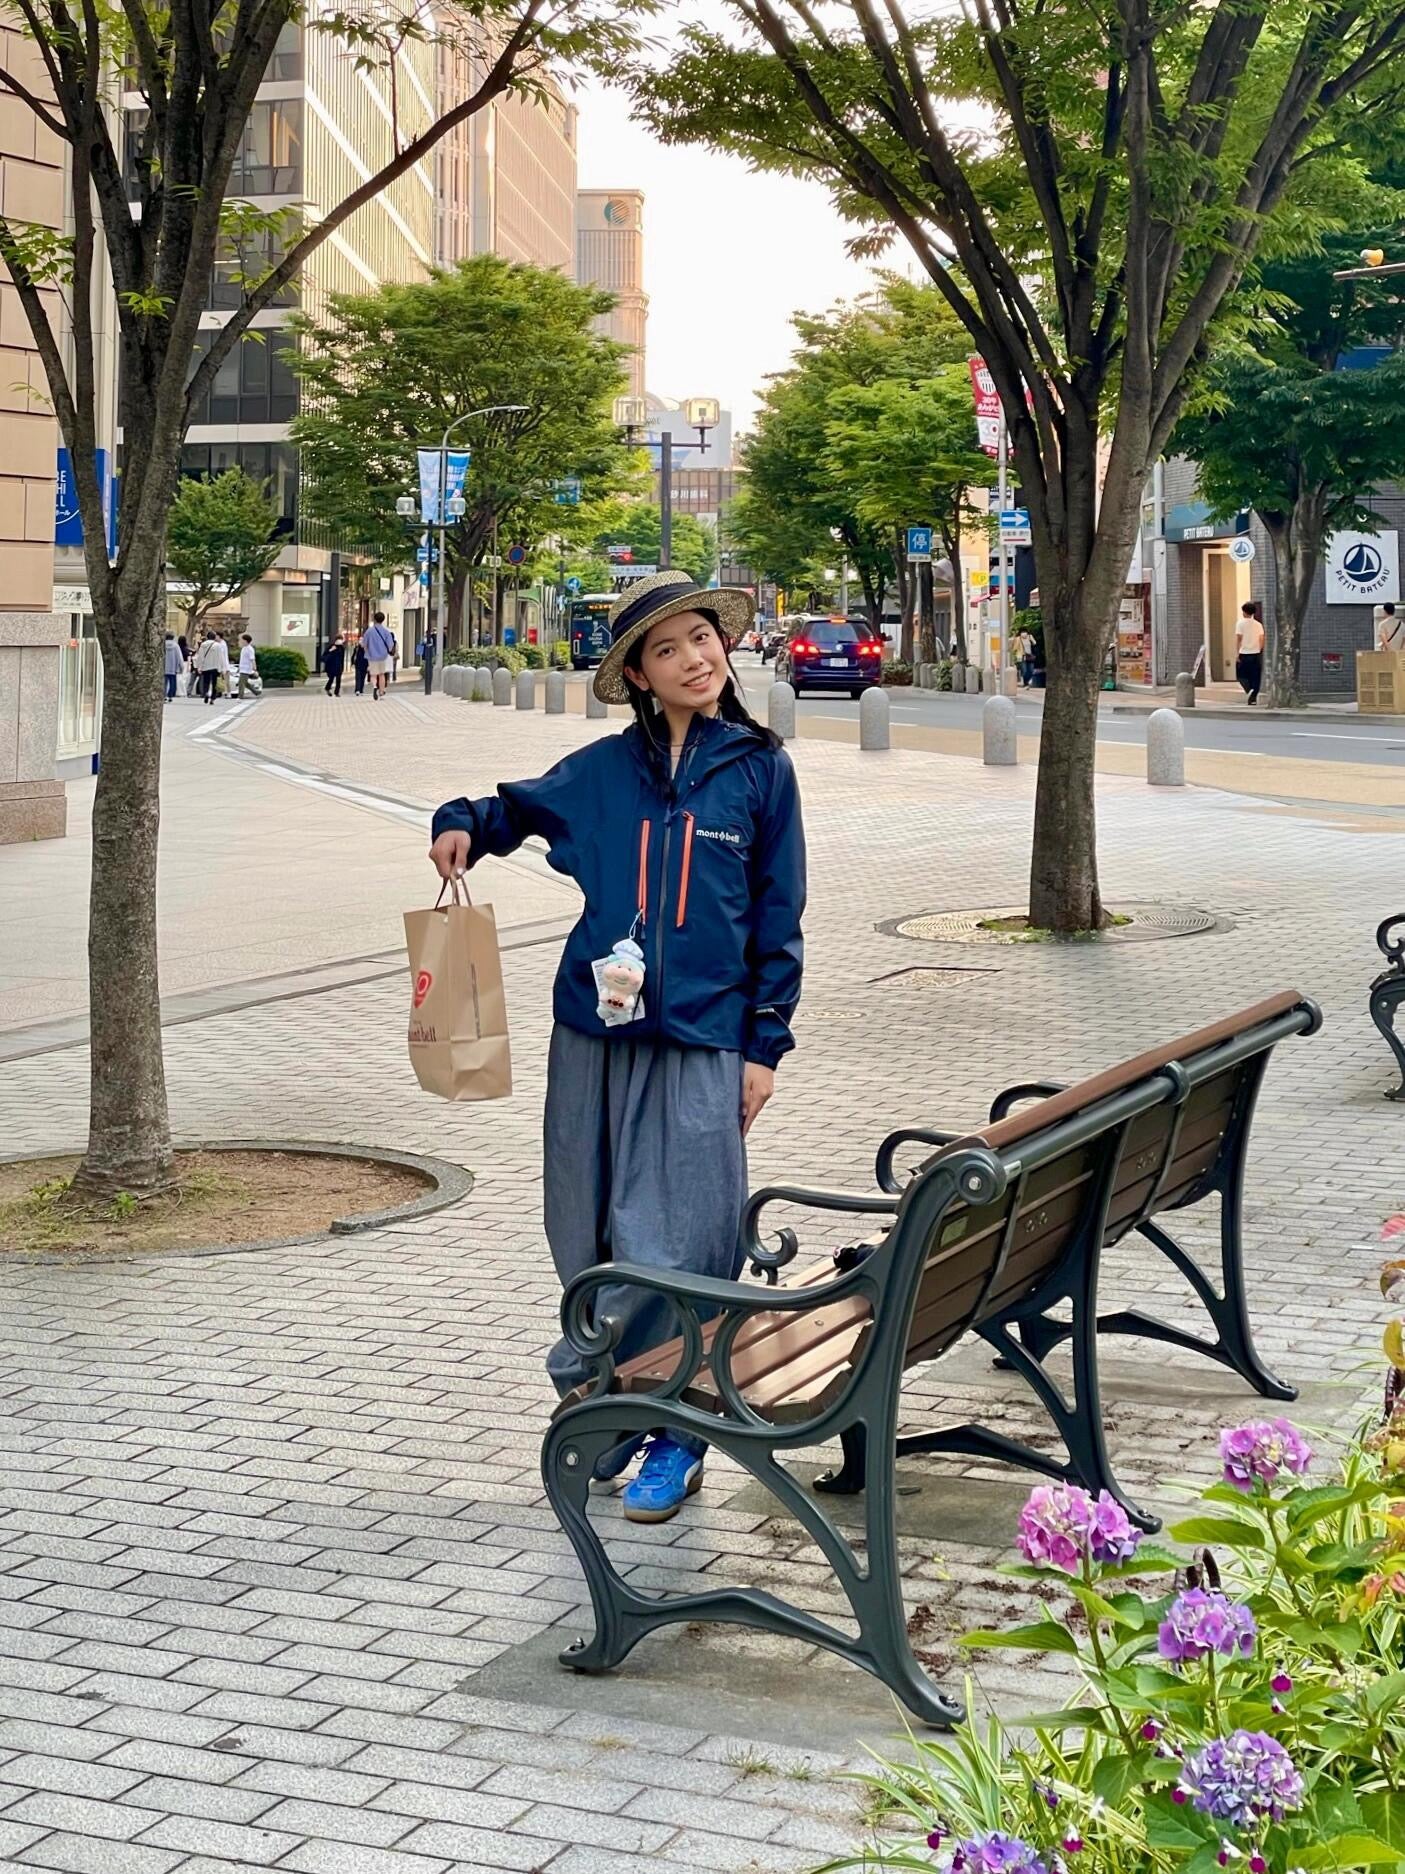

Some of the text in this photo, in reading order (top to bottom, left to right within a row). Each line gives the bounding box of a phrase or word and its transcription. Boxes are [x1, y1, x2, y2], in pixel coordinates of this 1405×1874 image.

[912, 533, 927, 550] 停
[1335, 568, 1391, 594] PETIT BATEAU
